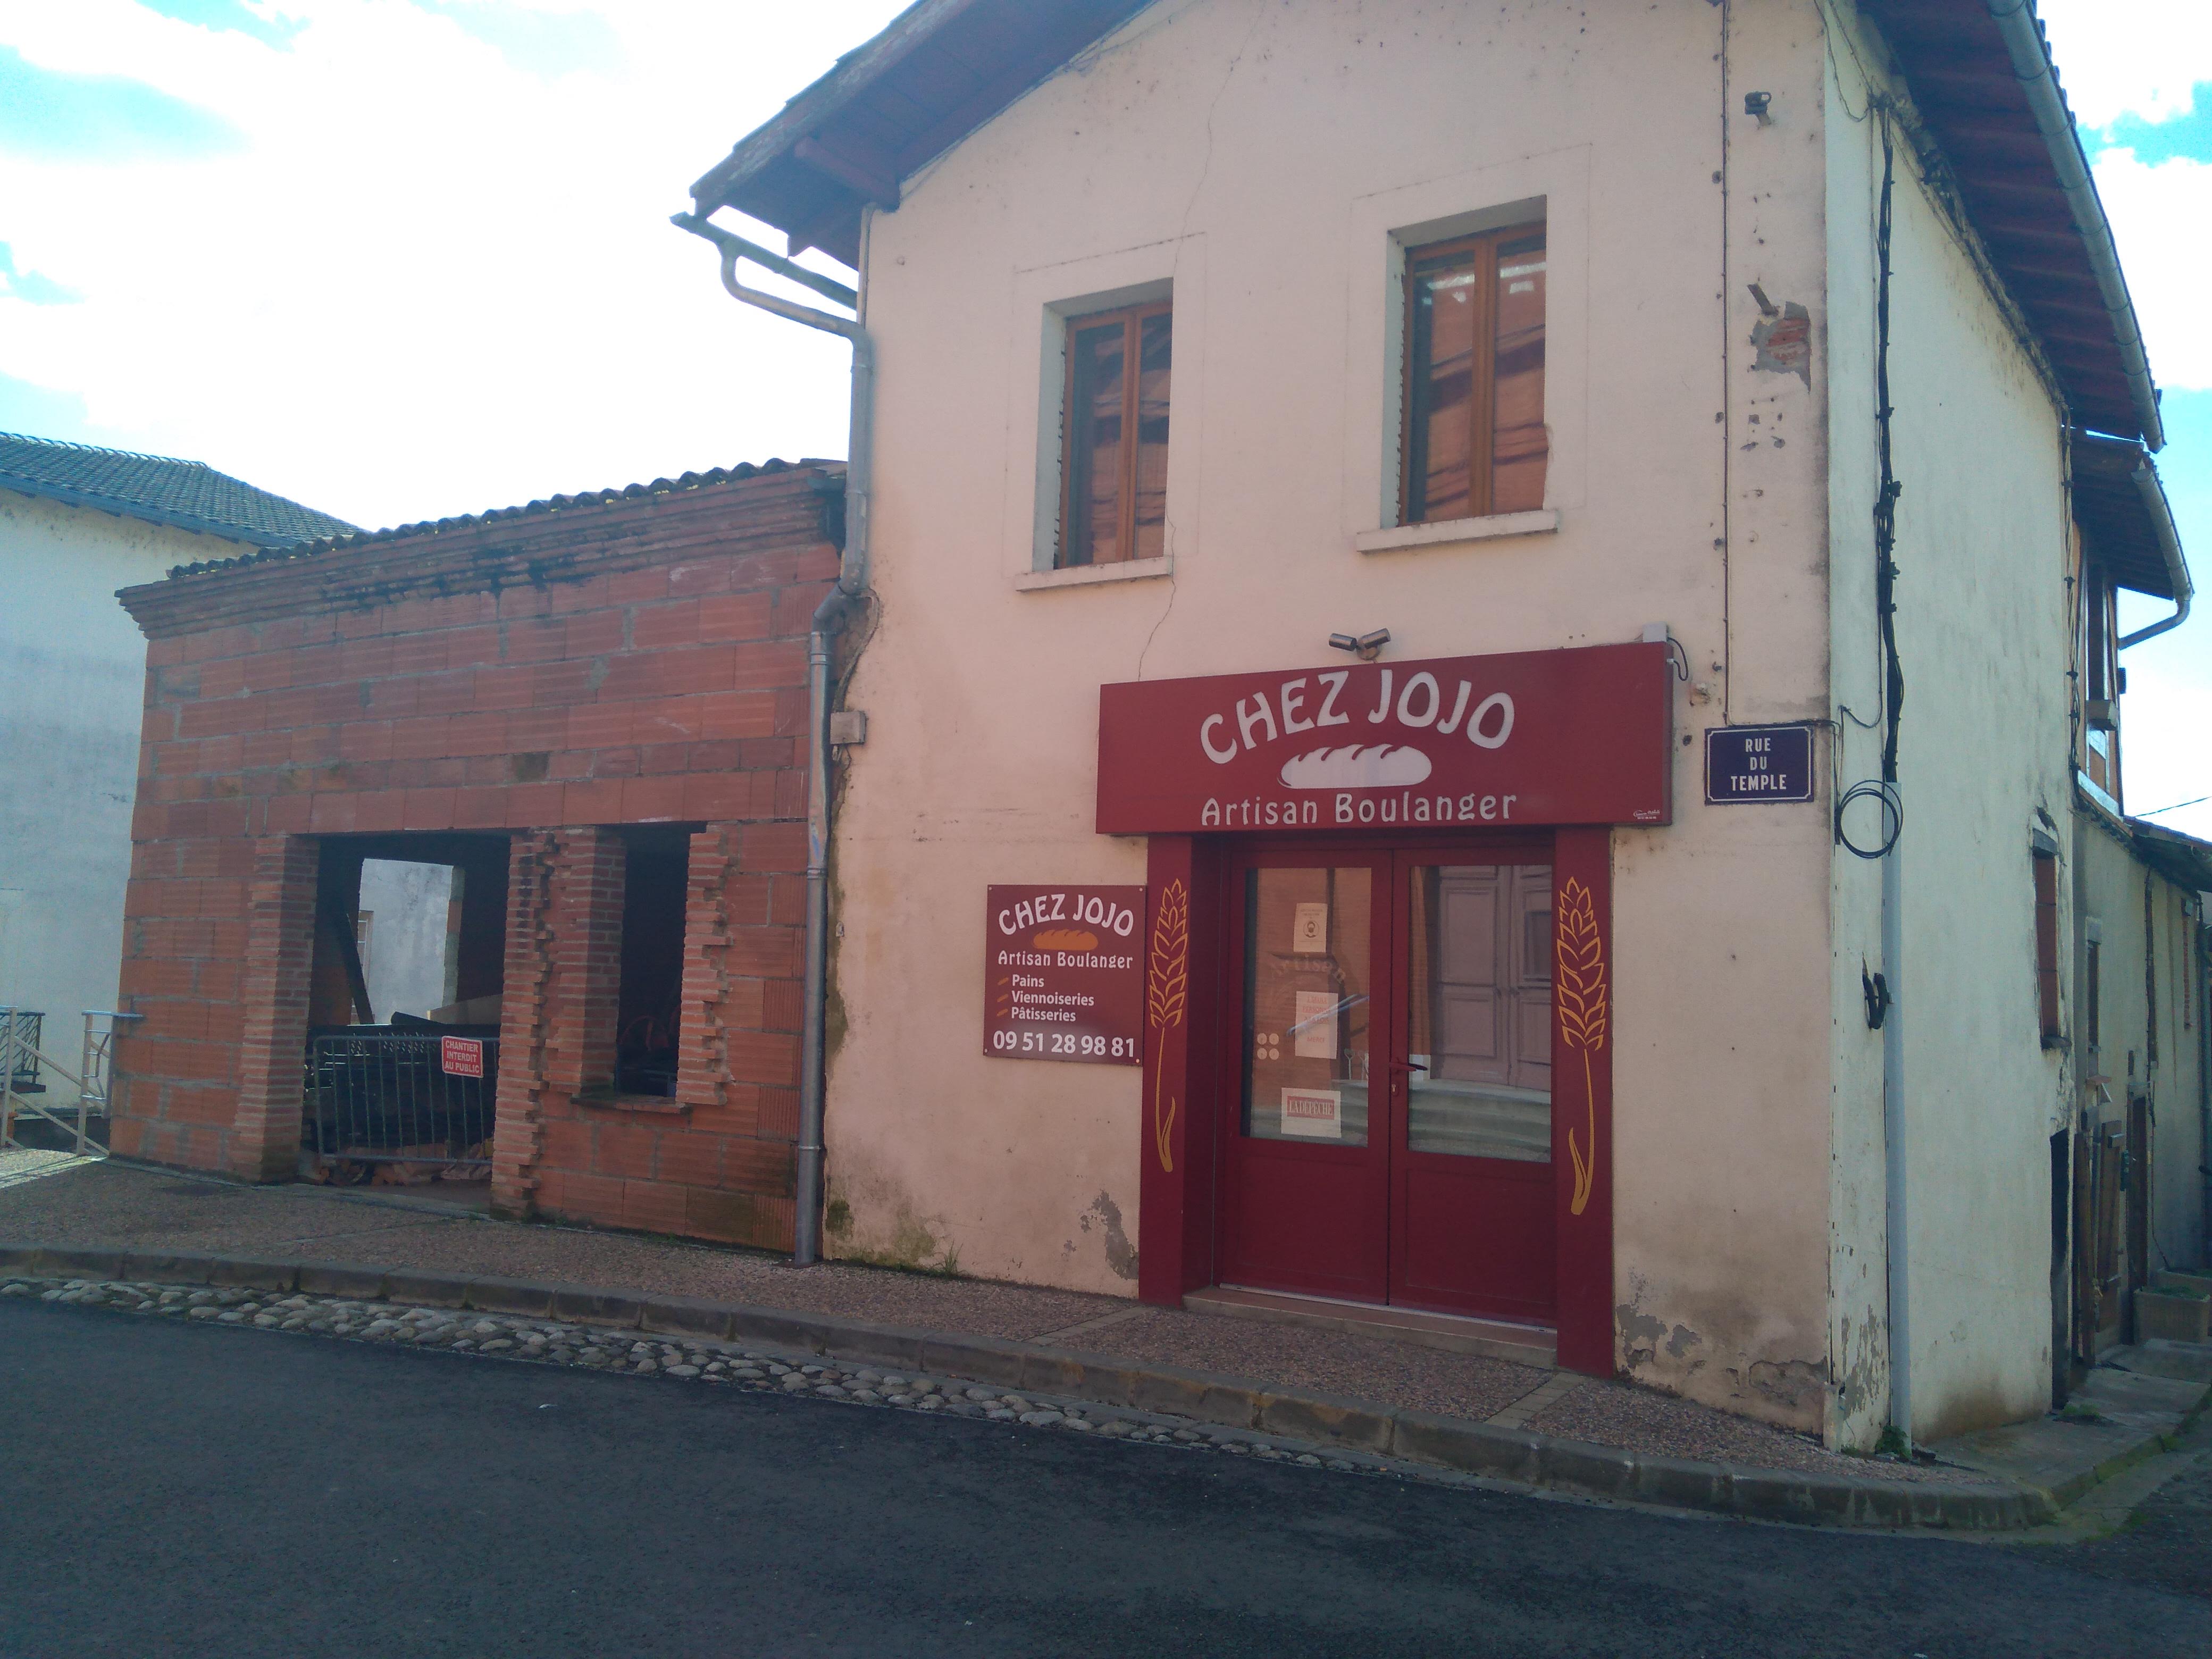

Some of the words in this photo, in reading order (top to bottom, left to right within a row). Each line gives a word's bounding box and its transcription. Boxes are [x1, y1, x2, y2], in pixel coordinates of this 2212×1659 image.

[1201, 671, 1350, 764] CHEZ
[1368, 669, 1515, 749] JOJO
[1745, 738, 1771, 752] RUE
[1750, 756, 1767, 770] DU
[1730, 774, 1787, 791] TEMPLE
[1201, 797, 1317, 826] Artisan
[1336, 792, 1516, 823] Boulanger
[999, 894, 1066, 935] CHEZ
[1073, 895, 1134, 936] JOJO
[998, 950, 1051, 966] Artisan
[1057, 952, 1133, 969] Boulanger
[1012, 974, 1044, 987] Pains
[1011, 990, 1094, 1006] Viennoiseries
[1011, 1006, 1076, 1022] Pâtisseries
[446, 1040, 479, 1053] CHANTIER
[993, 1030, 1017, 1050] 09
[1022, 1032, 1043, 1052] 51
[1051, 1033, 1076, 1054] 28
[1080, 1035, 1106, 1055] 98
[1111, 1037, 1134, 1057] 81
[447, 1050, 477, 1063] INTERDIT
[445, 1061, 454, 1069] AU
[455, 1062, 479, 1073] PUBLIC
